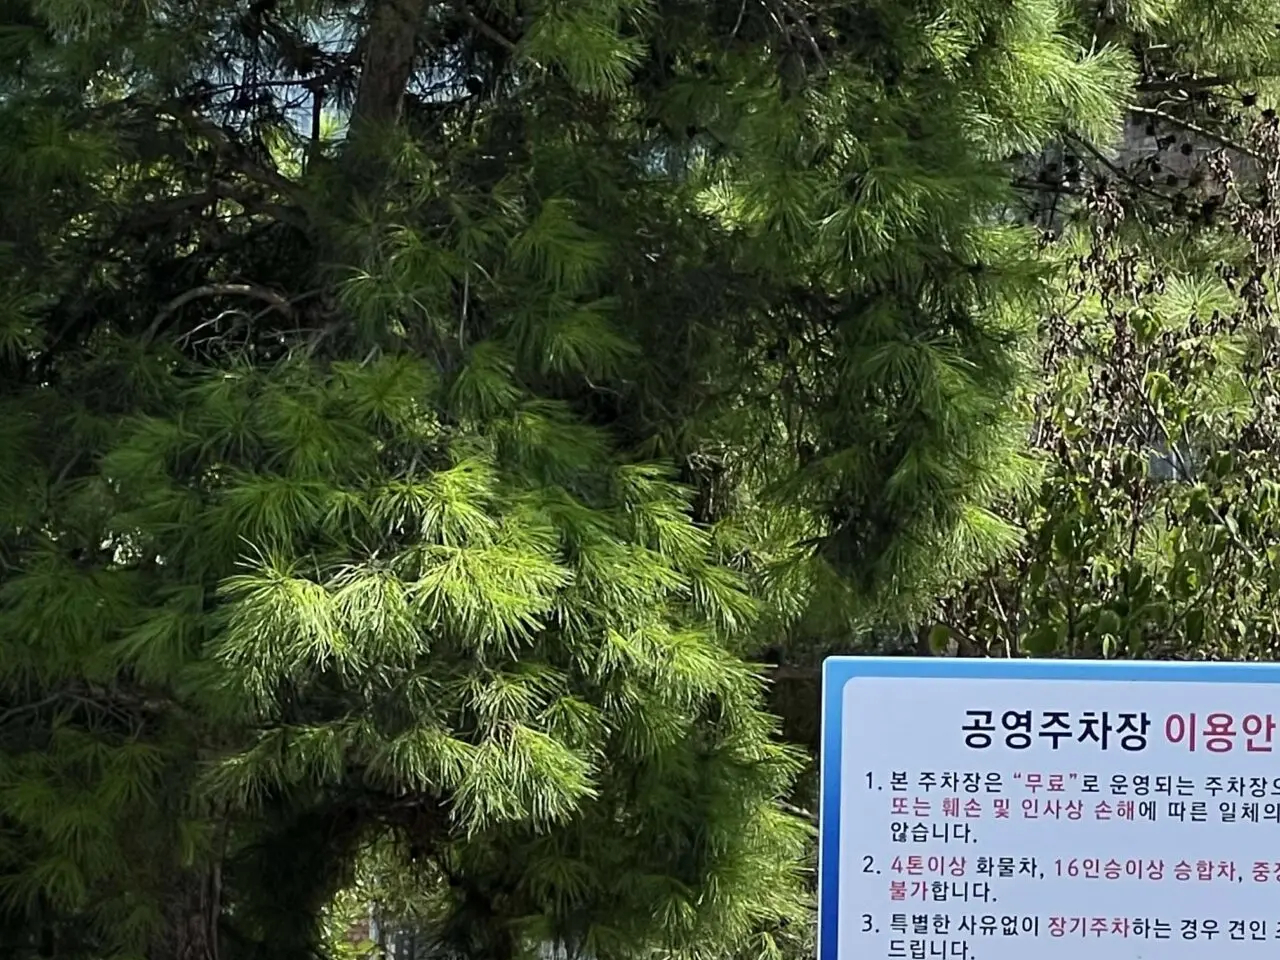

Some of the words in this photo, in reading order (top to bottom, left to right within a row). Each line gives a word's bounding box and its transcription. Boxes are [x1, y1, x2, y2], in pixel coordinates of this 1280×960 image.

[961, 708, 1152, 752] 공영주차장
[865, 771, 883, 792] 1.
[889, 770, 909, 792] 본
[917, 771, 1004, 794] 주차장은
[1108, 773, 1196, 797] 운영되는
[890, 796, 932, 818] 또는
[941, 796, 983, 819] 훼손
[993, 797, 1010, 819] 및
[1021, 798, 1084, 821] 인사상
[1093, 799, 1158, 822] 손해에
[1167, 800, 1209, 823] 따른
[1218, 801, 1280, 824] 일체의
[890, 821, 978, 844] 않습니다.
[862, 854, 882, 875] 2.
[890, 855, 968, 877] 4톤이상
[975, 856, 1045, 881] 화물차,
[1054, 857, 1165, 881] 16인승이상
[1173, 859, 1243, 884] 승합차,
[888, 880, 998, 904] 불가합니다.
[861, 913, 880, 934] 3.
[889, 913, 952, 936] 특별한
[957, 914, 1039, 938] 사유없이
[1047, 916, 1173, 940] 장기주차하는
[1179, 918, 1221, 941] 경우
[1227, 919, 1267, 941] 견인
